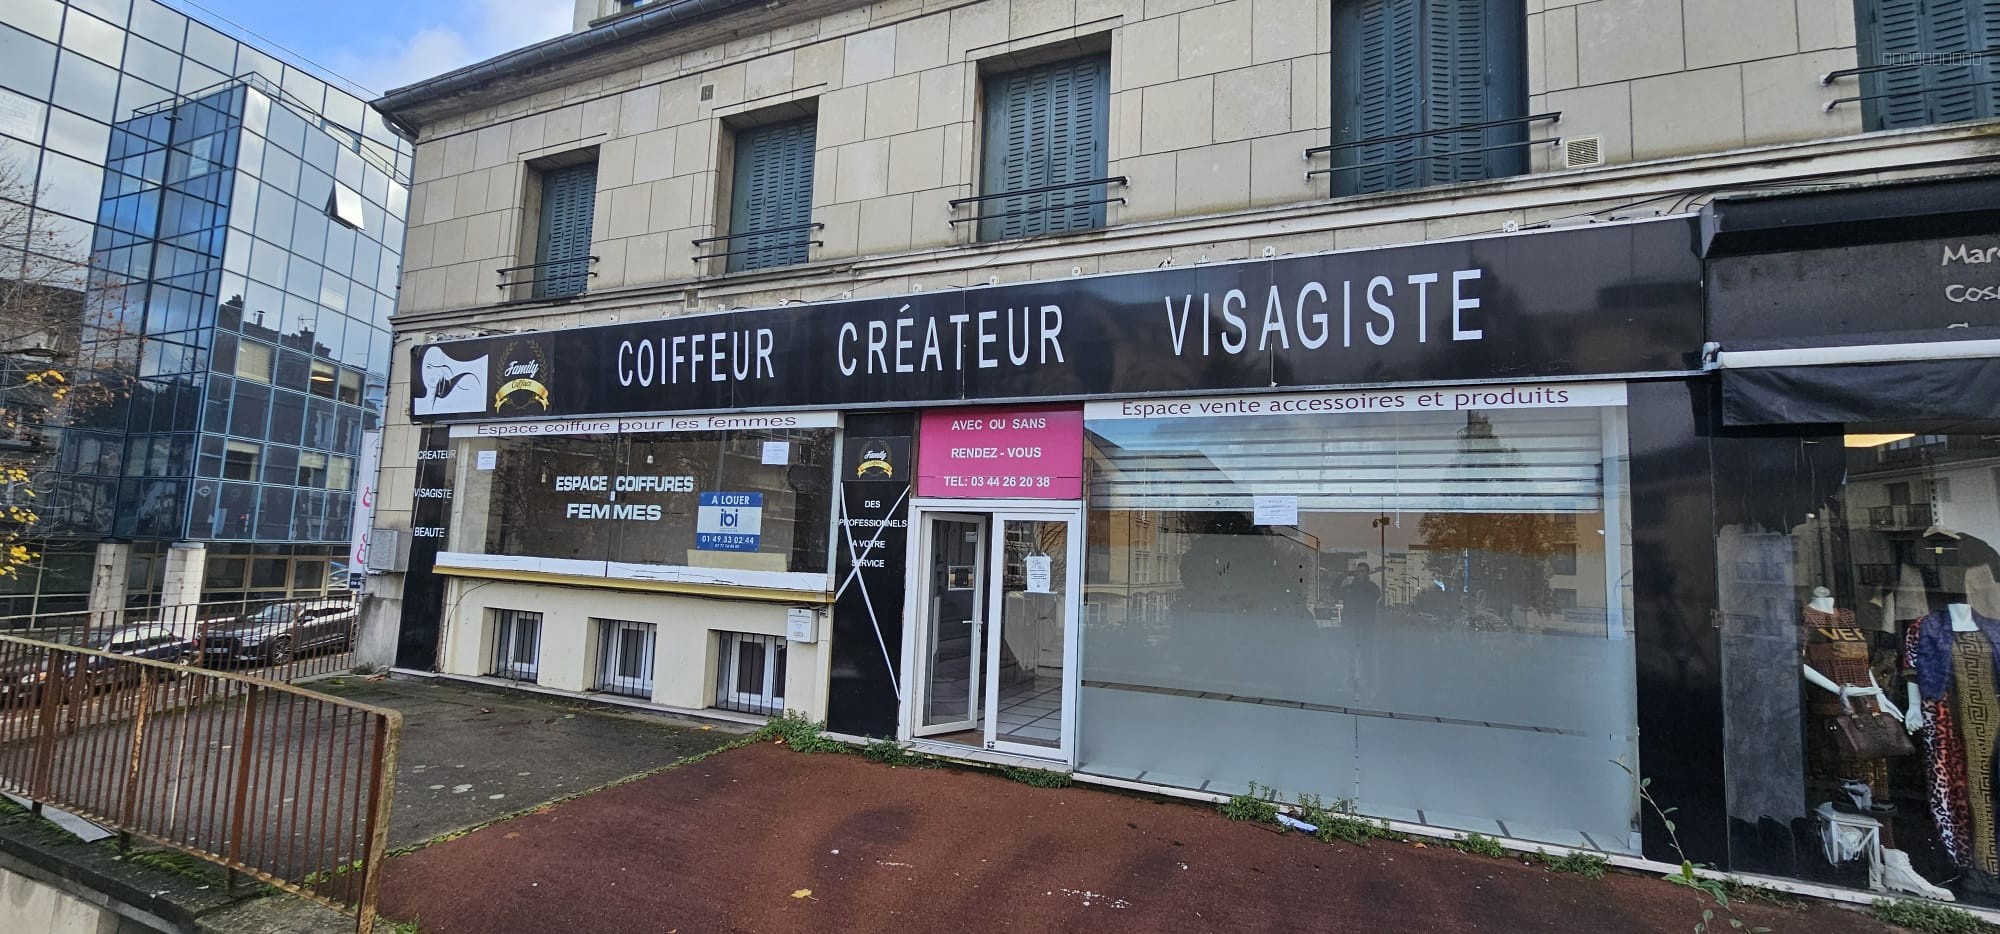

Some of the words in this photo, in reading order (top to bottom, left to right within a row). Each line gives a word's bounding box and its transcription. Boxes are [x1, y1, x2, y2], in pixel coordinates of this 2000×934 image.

[618, 328, 775, 387] COIFFEUR
[838, 303, 1065, 377] CRÉATEUR
[1165, 269, 1483, 356] VISAGISTE
[505, 360, 539, 378] Family
[1122, 401, 1191, 418] Espace
[1199, 400, 1261, 414] vente
[1269, 394, 1405, 412] accessoires
[1417, 391, 1444, 407] et
[1455, 387, 1569, 411] produits
[477, 425, 538, 435] Espace
[544, 420, 610, 432] coiffure
[620, 421, 664, 432] pour
[671, 418, 699, 429] les
[708, 417, 797, 428] femmes
[952, 419, 983, 431] AVEC
[989, 418, 1006, 429] OU
[1012, 418, 1046, 429] SANS
[417, 449, 457, 459] CREATEUR
[951, 448, 998, 459] RENDEZ
[1007, 447, 1042, 458] VOUS
[556, 475, 608, 491] ESPACE
[615, 476, 694, 492] COIFFURES
[944, 476, 968, 487] TEL:
[971, 477, 984, 487] 03
[987, 477, 1000, 487] 44
[1003, 477, 1017, 487] 26
[1019, 477, 1033, 487] 20
[1036, 477, 1050, 487] 38
[414, 488, 453, 499] VISAGISTE
[711, 496, 719, 505] A
[721, 496, 750, 505] LOUER
[864, 500, 881, 508] DES
[566, 504, 662, 521] FEMMES
[720, 509, 738, 527] ibi
[414, 527, 445, 537] BEAUTE
[712, 535, 721, 544] 49
[723, 536, 732, 544] 33
[734, 536, 743, 544] 02
[745, 537, 754, 545] 44
[852, 559, 885, 567] SRVICE
